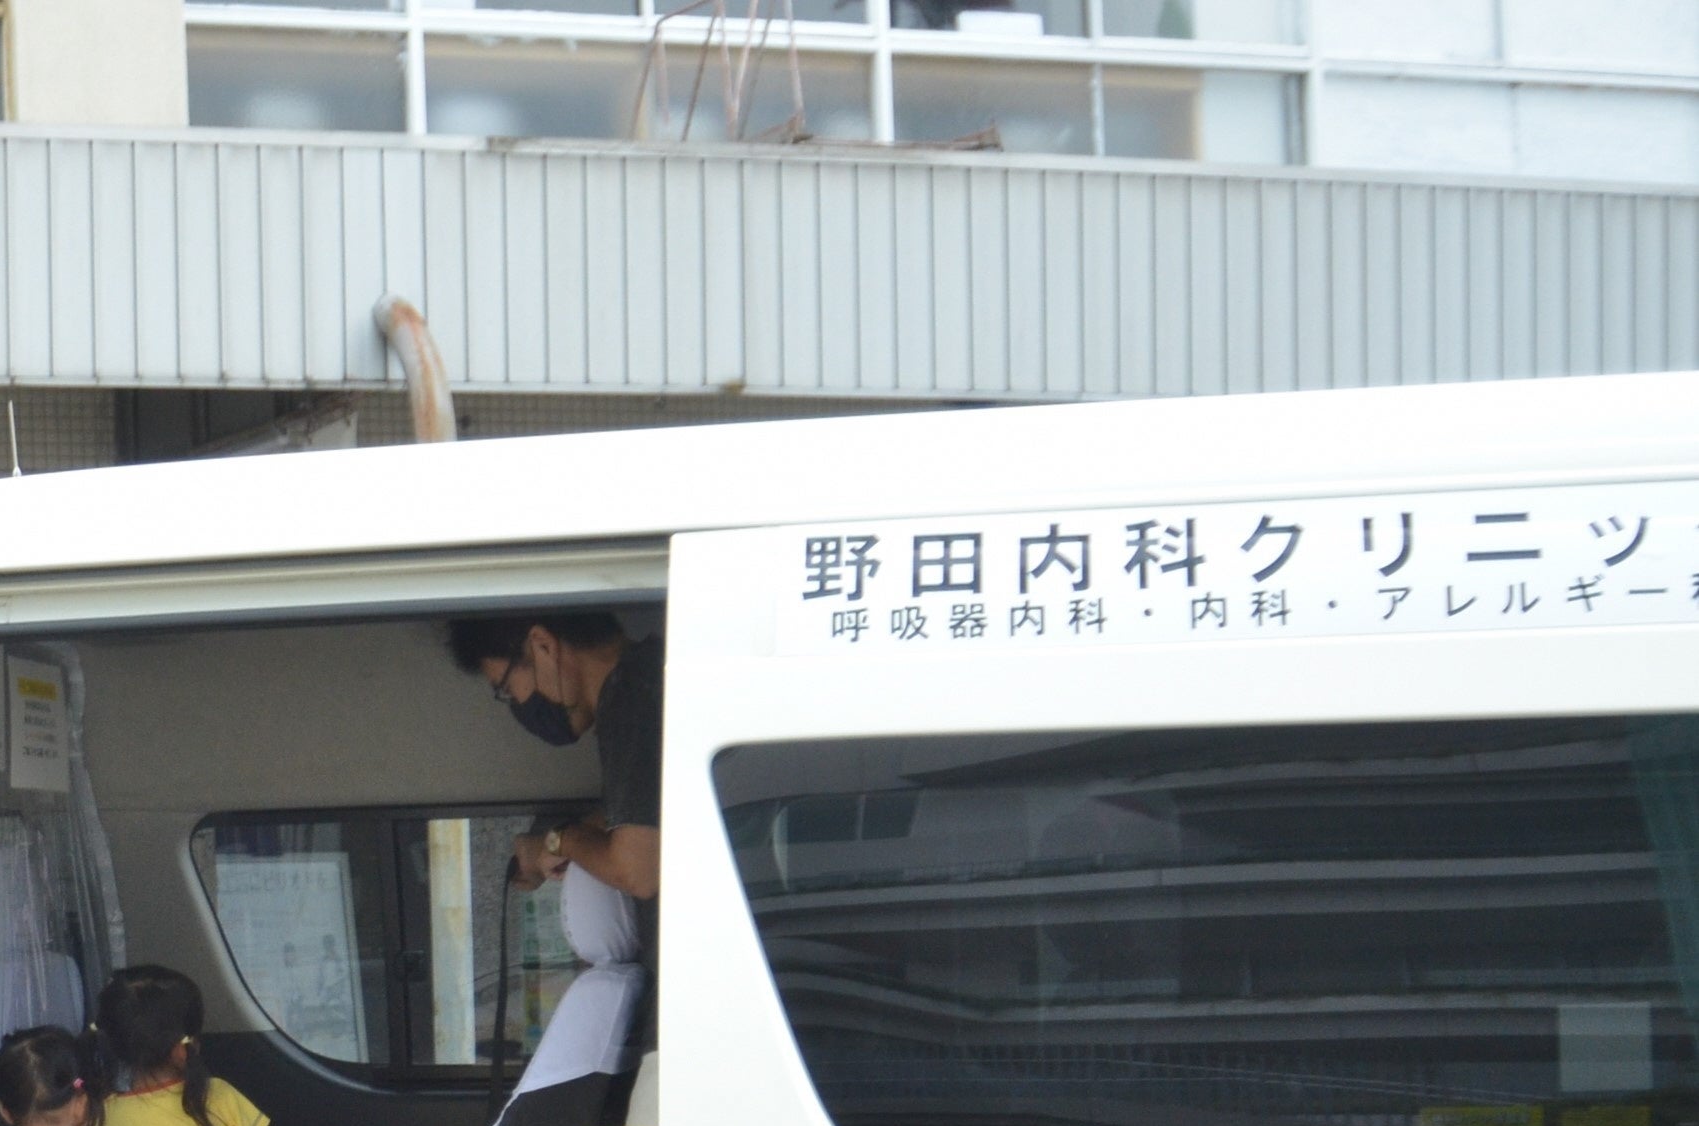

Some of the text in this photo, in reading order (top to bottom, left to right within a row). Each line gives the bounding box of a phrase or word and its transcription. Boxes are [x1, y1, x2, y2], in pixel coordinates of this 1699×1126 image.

[802, 510, 1699, 602] 野田内科クリニッ
[832, 571, 1699, 644] 呼吸器内科・内科・アレルギー
